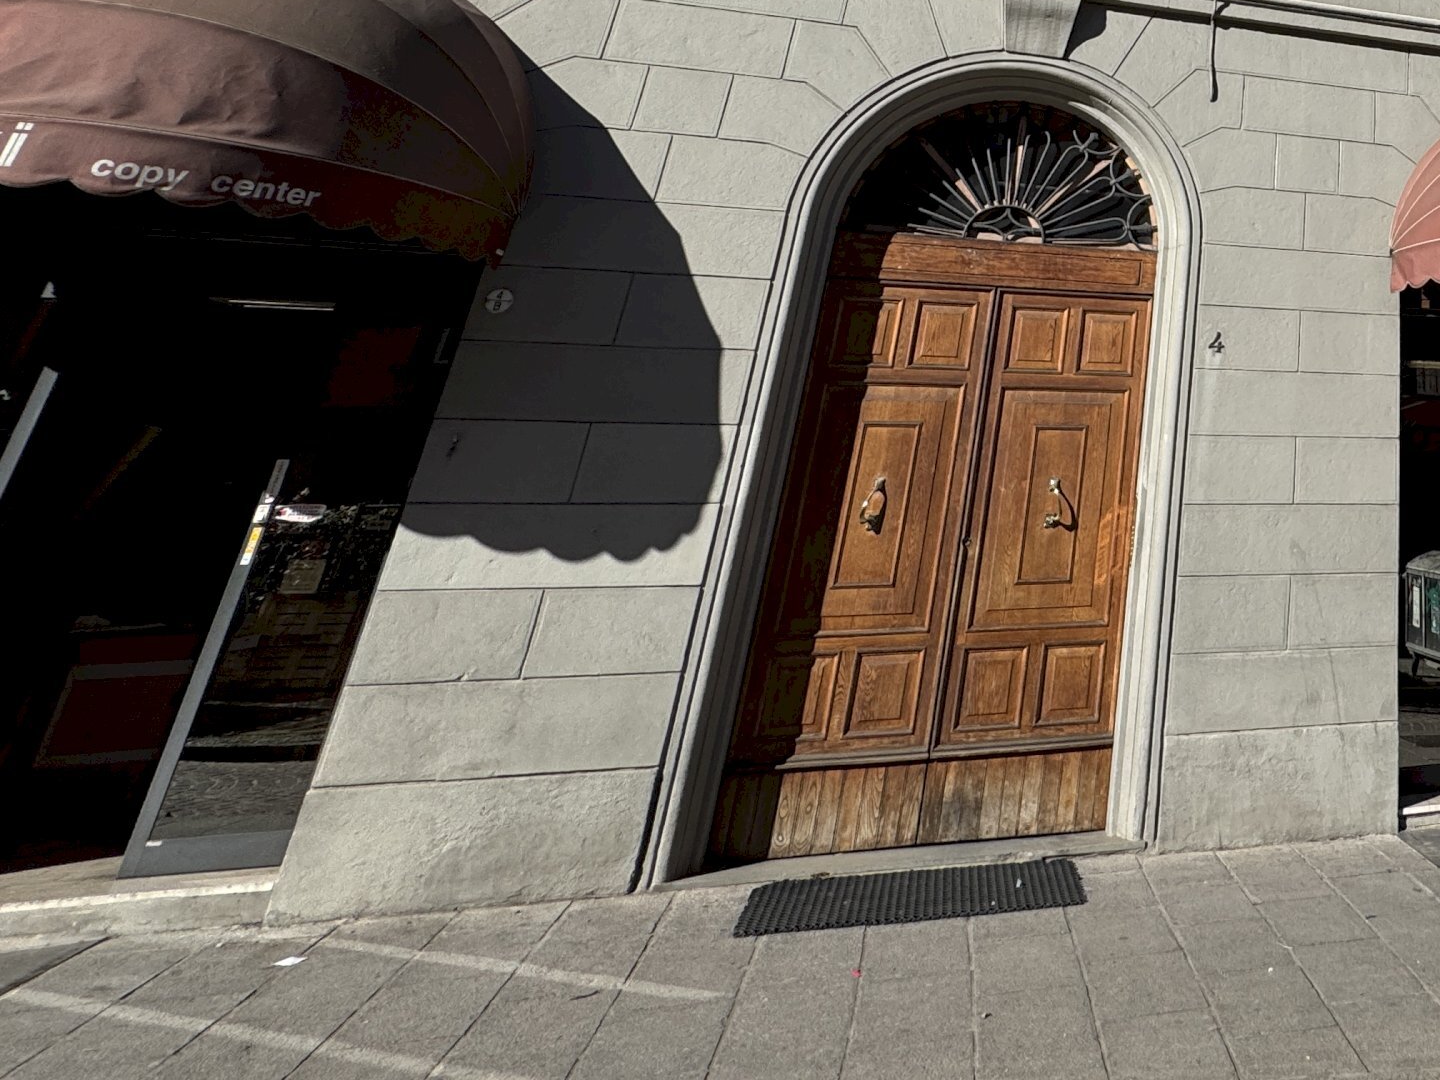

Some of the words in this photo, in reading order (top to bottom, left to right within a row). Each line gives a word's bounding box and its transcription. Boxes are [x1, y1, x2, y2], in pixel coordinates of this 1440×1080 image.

[91, 159, 189, 191] copy
[211, 174, 321, 207] center
[1208, 331, 1225, 353] 4
